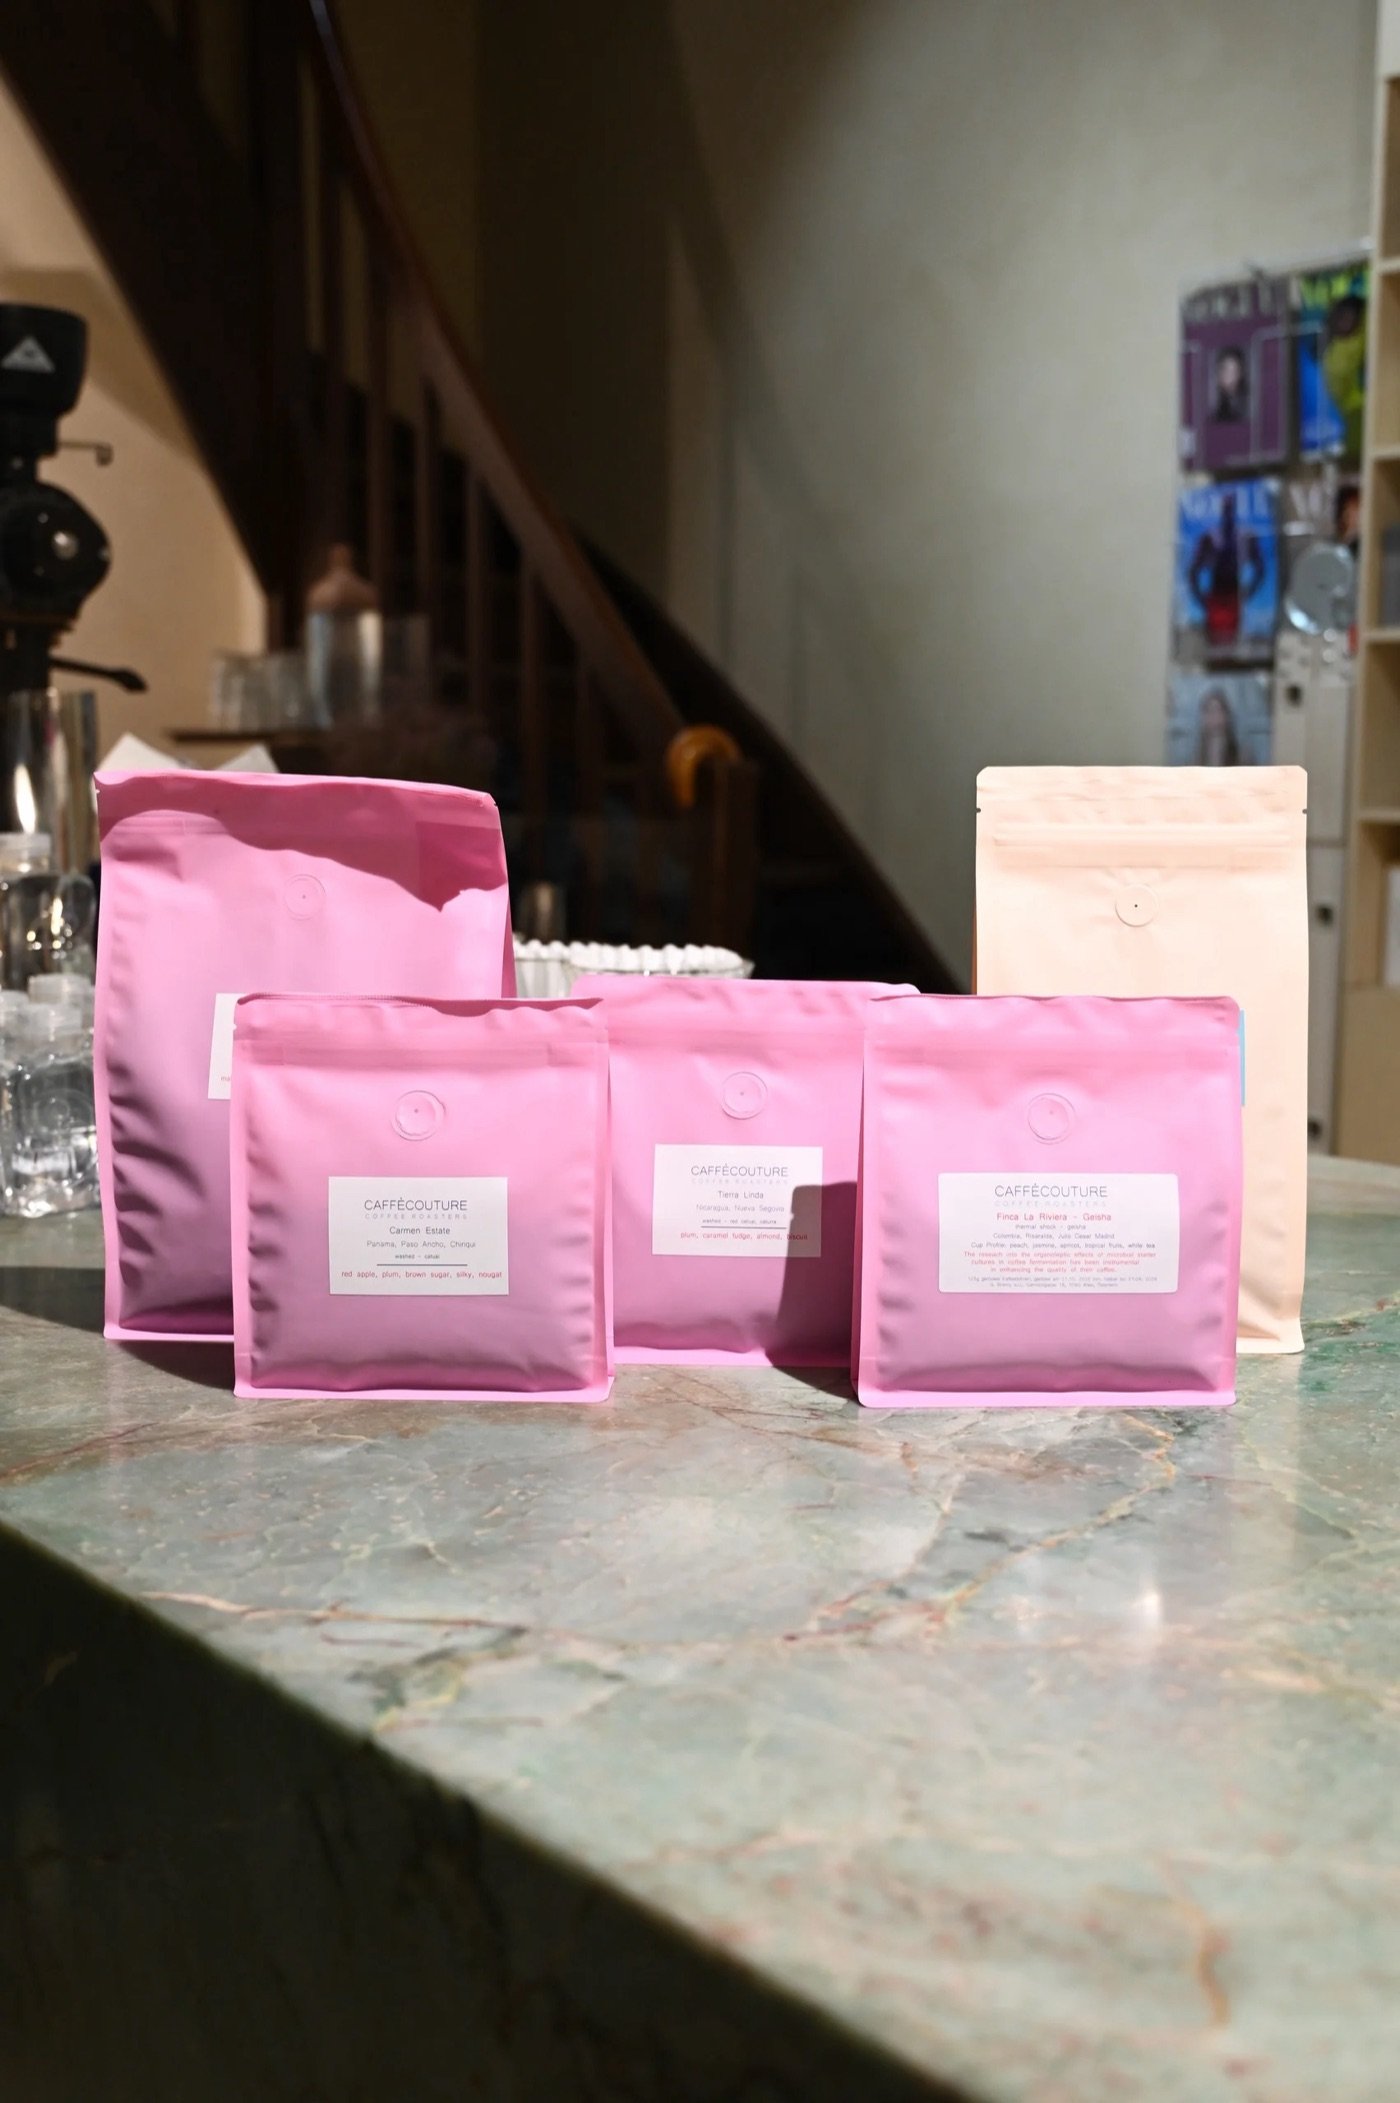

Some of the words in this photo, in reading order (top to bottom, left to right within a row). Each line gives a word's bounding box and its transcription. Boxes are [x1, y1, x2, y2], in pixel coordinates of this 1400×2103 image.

[718, 1191, 739, 1199] Tierra
[744, 1191, 764, 1199] Linda
[759, 1205, 785, 1214] Segovia
[997, 1213, 1019, 1221] Finca
[1024, 1213, 1034, 1221] La
[1039, 1213, 1068, 1221] Riviera
[1083, 1213, 1112, 1221] Geisha
[389, 1226, 421, 1235] Carmen
[426, 1226, 451, 1235] Estate
[680, 1232, 698, 1240] plum,
[703, 1232, 728, 1240] caramel
[732, 1232, 753, 1241] fudge,
[756, 1232, 782, 1241] almond,
[367, 1241, 397, 1249] Panama,
[422, 1241, 446, 1249] Ancho,
[357, 1271, 378, 1279] apple,
[382, 1271, 401, 1279] plum,
[431, 1271, 452, 1279] sugar,
[456, 1271, 475, 1279] silky,
[479, 1271, 502, 1279] nougat
